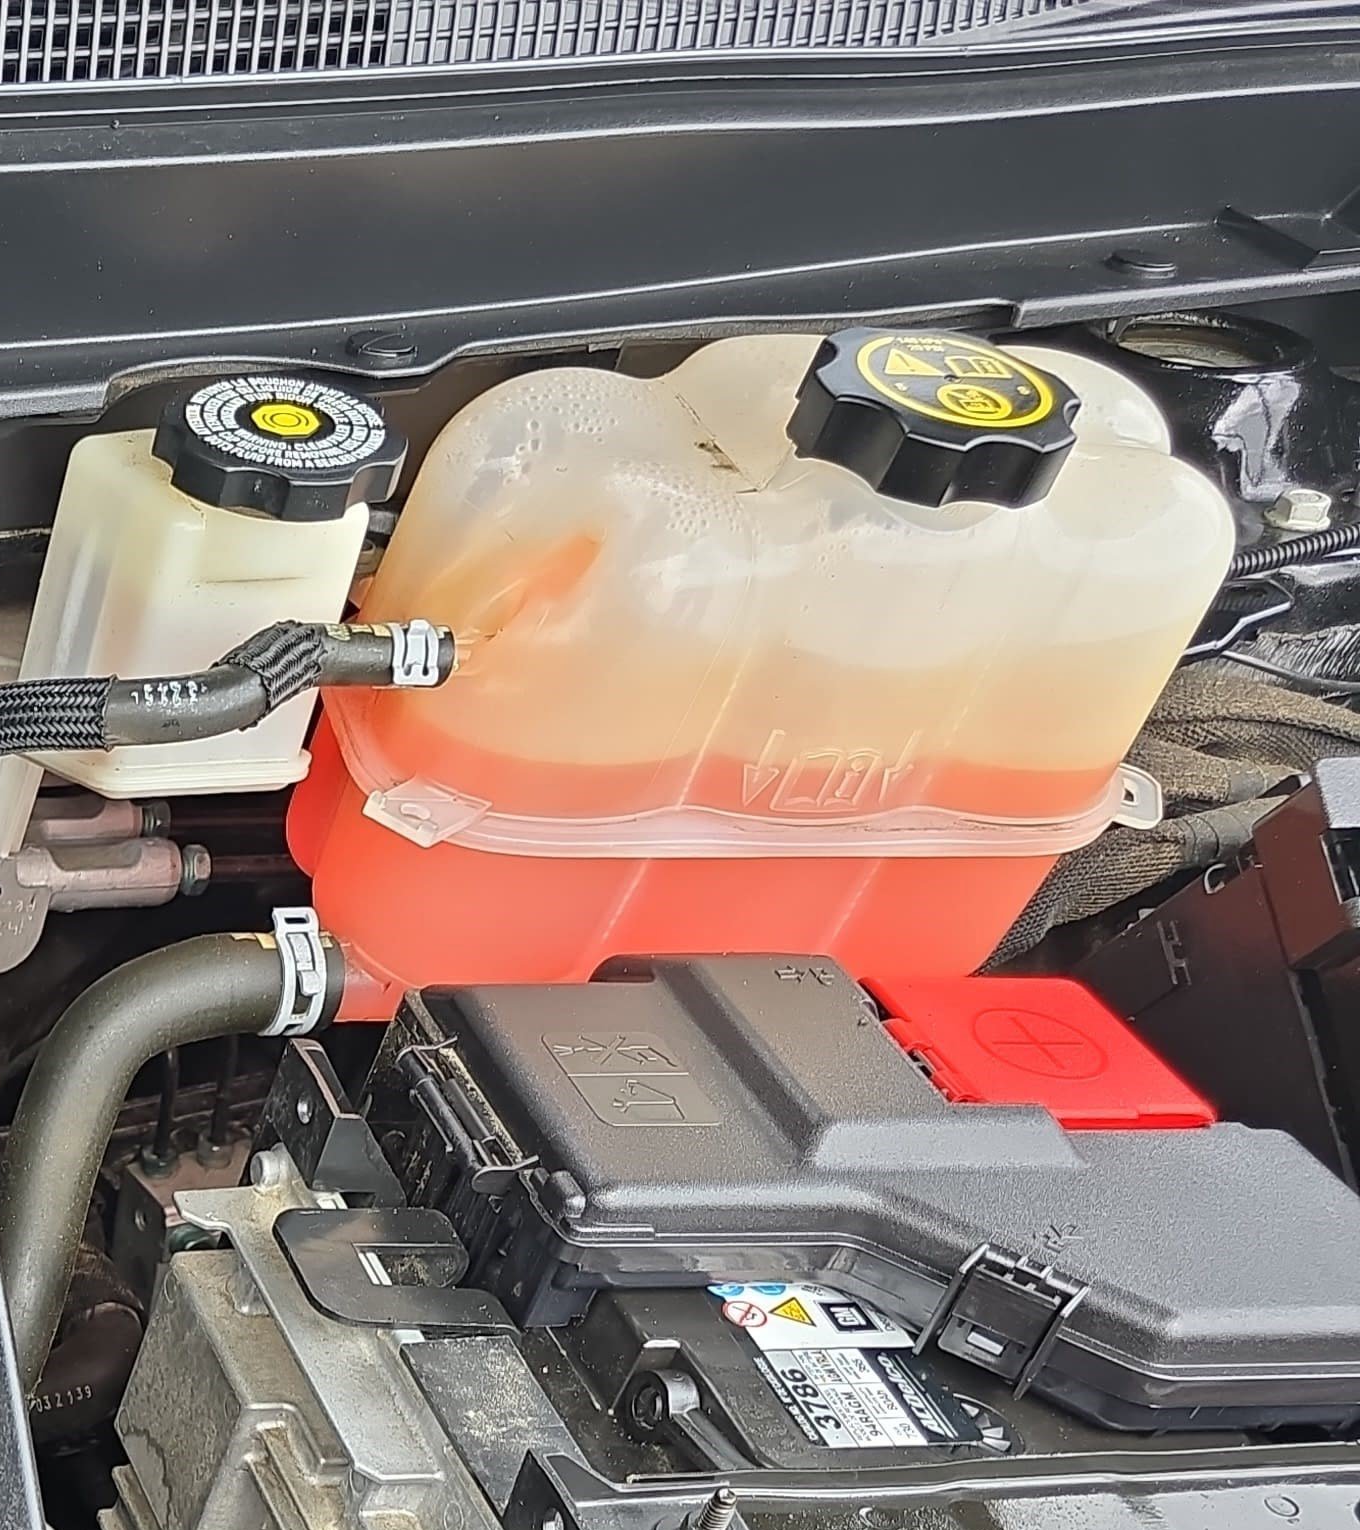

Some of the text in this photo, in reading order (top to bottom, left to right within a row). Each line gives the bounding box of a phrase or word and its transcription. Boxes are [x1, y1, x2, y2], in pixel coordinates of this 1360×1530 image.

[829, 1307, 864, 1326] GM
[777, 1369, 844, 1429] 3786
[839, 1391, 885, 1436] 94RAGM
[872, 1355, 948, 1435] ACDelco
